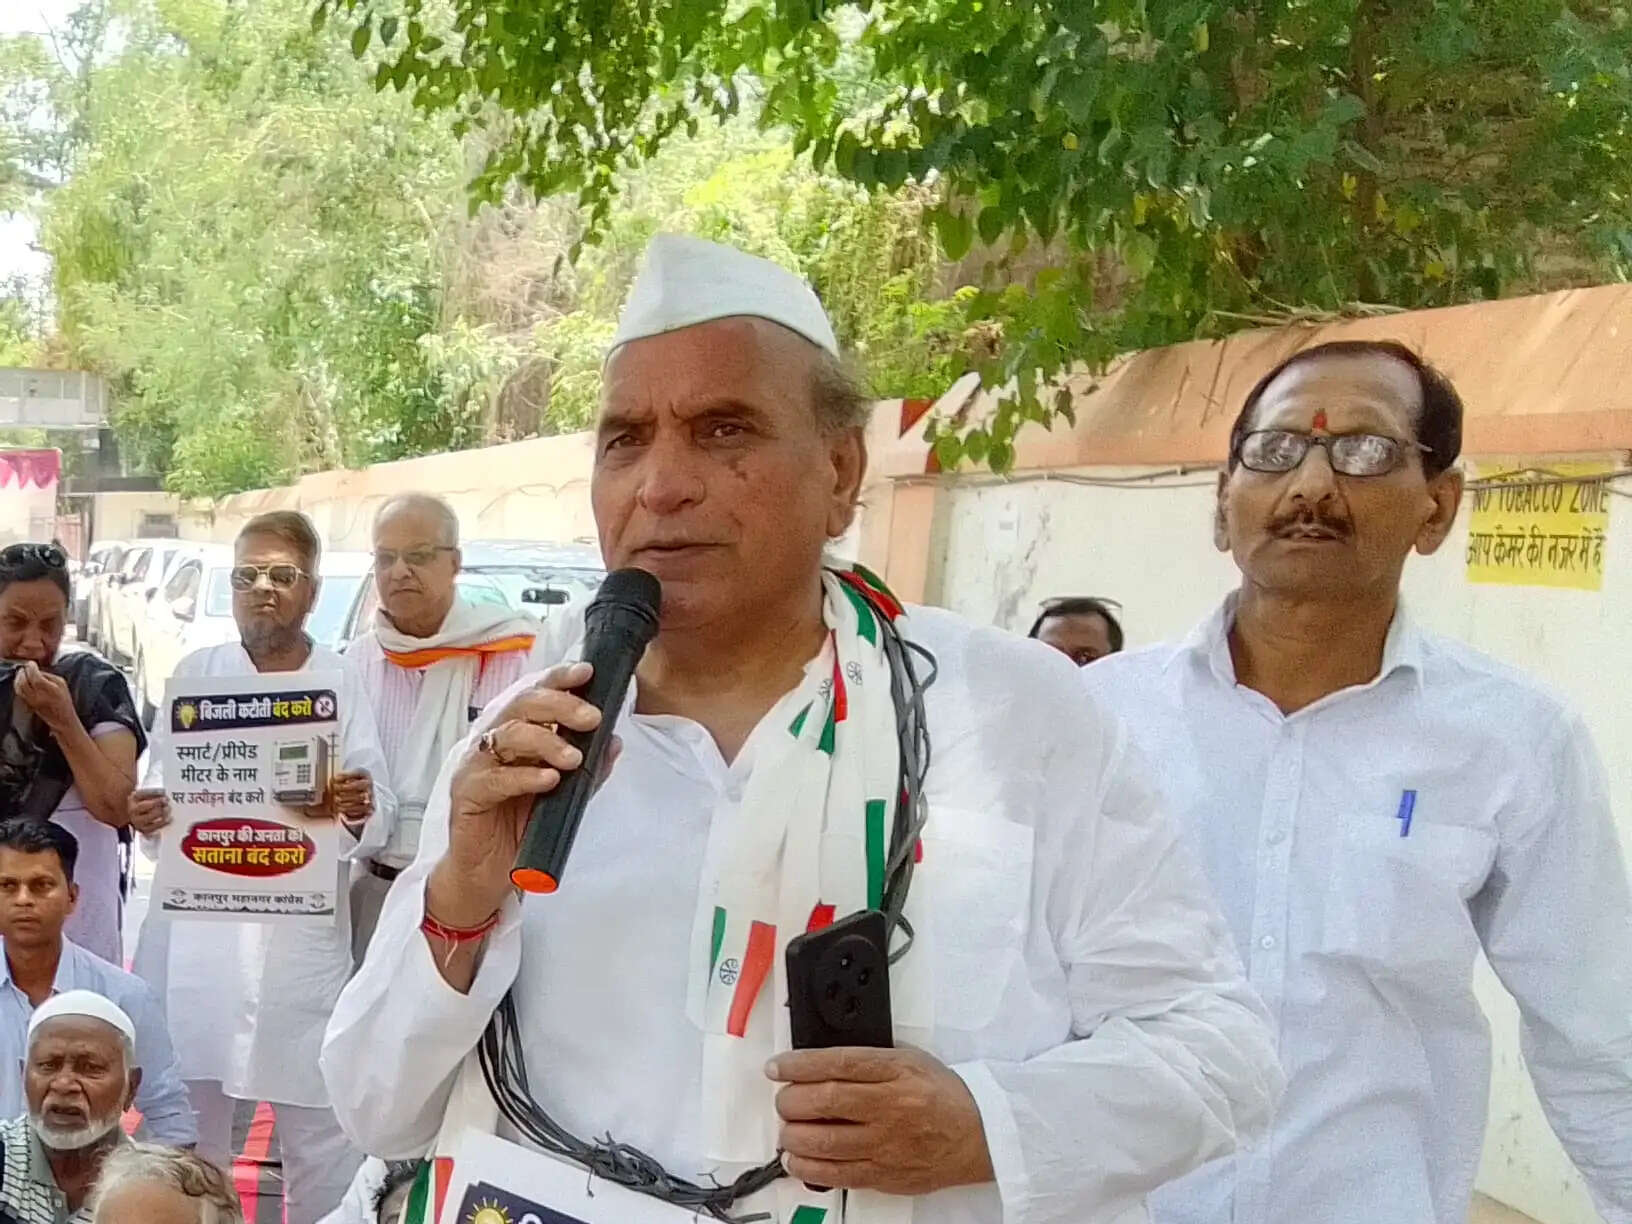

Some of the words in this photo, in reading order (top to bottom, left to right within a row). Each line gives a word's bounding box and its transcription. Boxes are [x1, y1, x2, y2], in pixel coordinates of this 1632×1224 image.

[192, 847, 243, 865] सताना
[247, 845, 271, 866] बंद
[274, 844, 306, 865] करो
